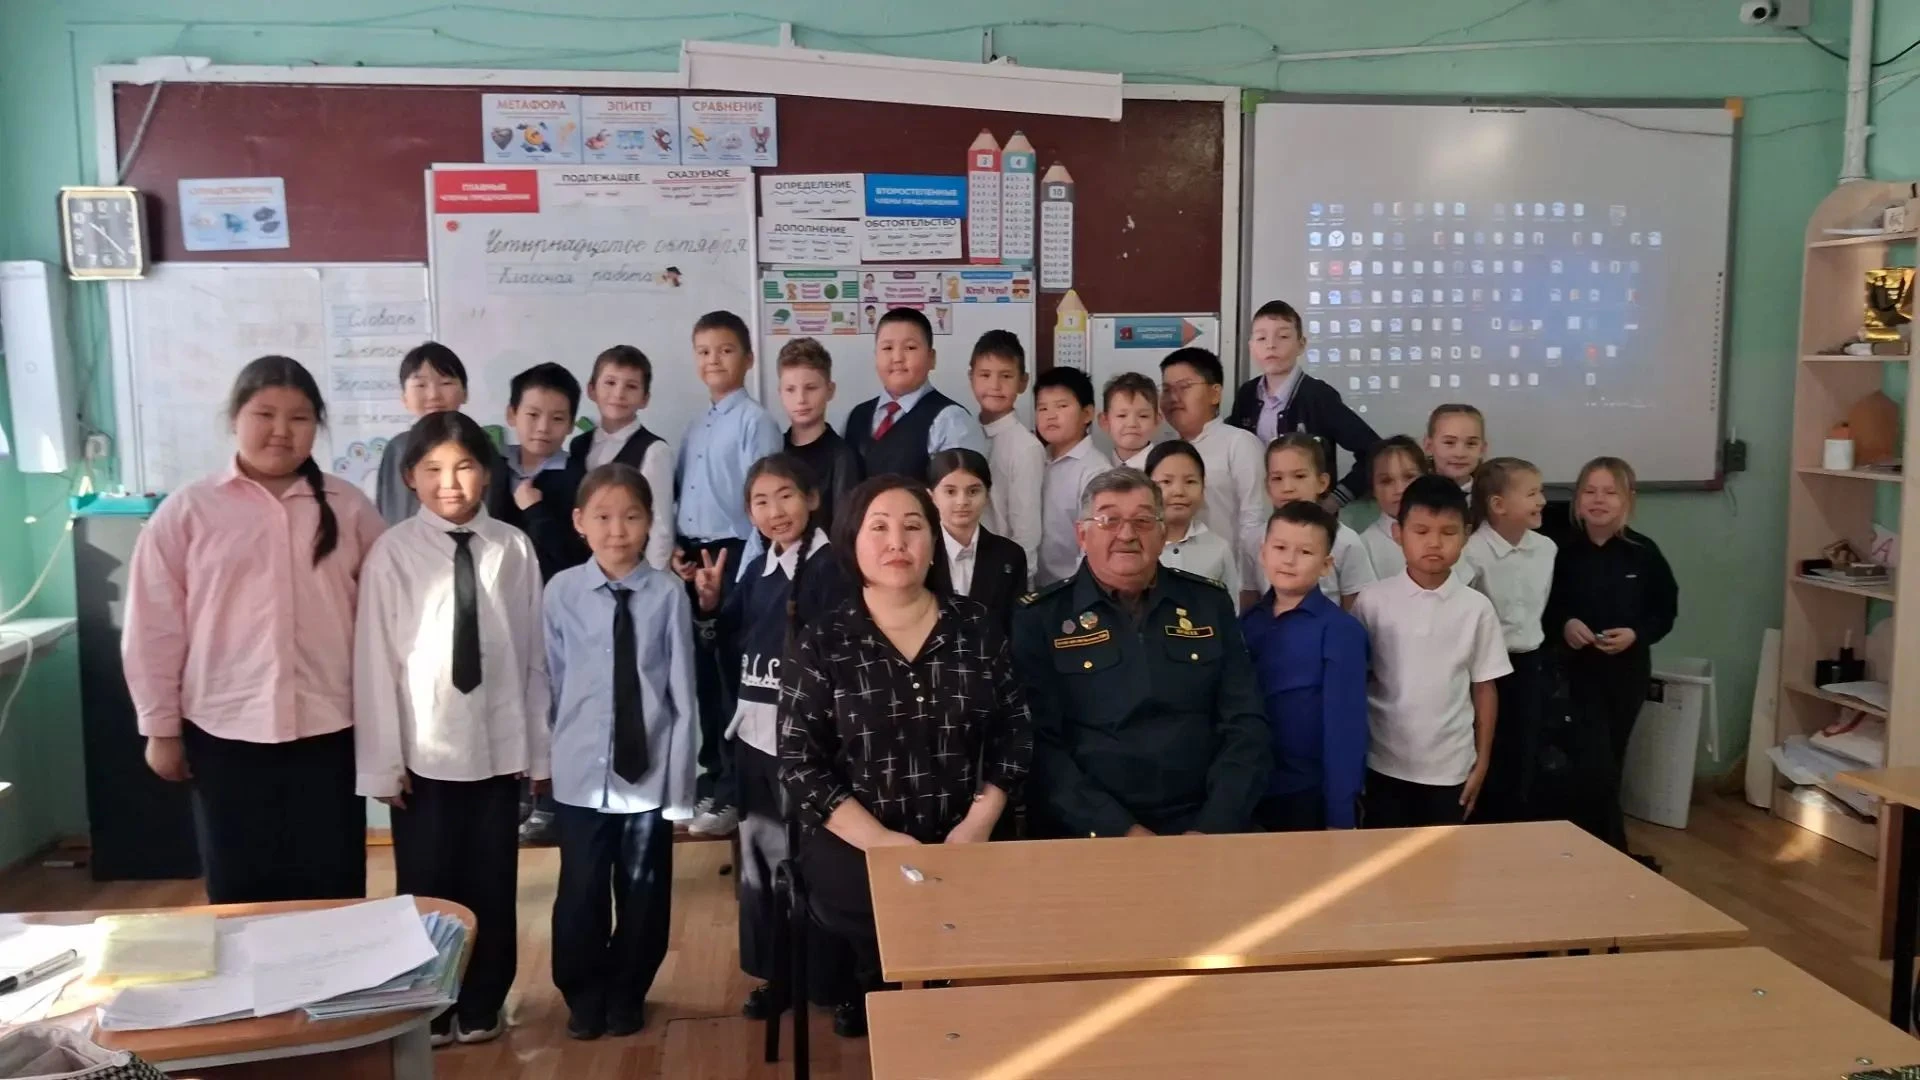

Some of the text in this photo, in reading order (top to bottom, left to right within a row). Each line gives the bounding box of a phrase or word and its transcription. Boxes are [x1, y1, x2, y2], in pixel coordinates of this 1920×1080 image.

[496, 99, 567, 110] МЕТАФОРА
[607, 100, 653, 112] ЭПИТЕТ
[692, 101, 764, 112] СРАВНЕНИЕ
[562, 173, 641, 183] ПОДЛЕЖАЩЕЕ
[667, 169, 731, 179] СКАЗУЕМОЕ
[774, 180, 852, 190] ОПРЕДЕЛЕНИЕ
[774, 223, 847, 234] ДОПОЛНЕНИЕ
[865, 218, 957, 229] ОБСТОЯТЕЛЬСТВО
[498, 263, 653, 287] Классная работа
[348, 307, 416, 333] Словарь
